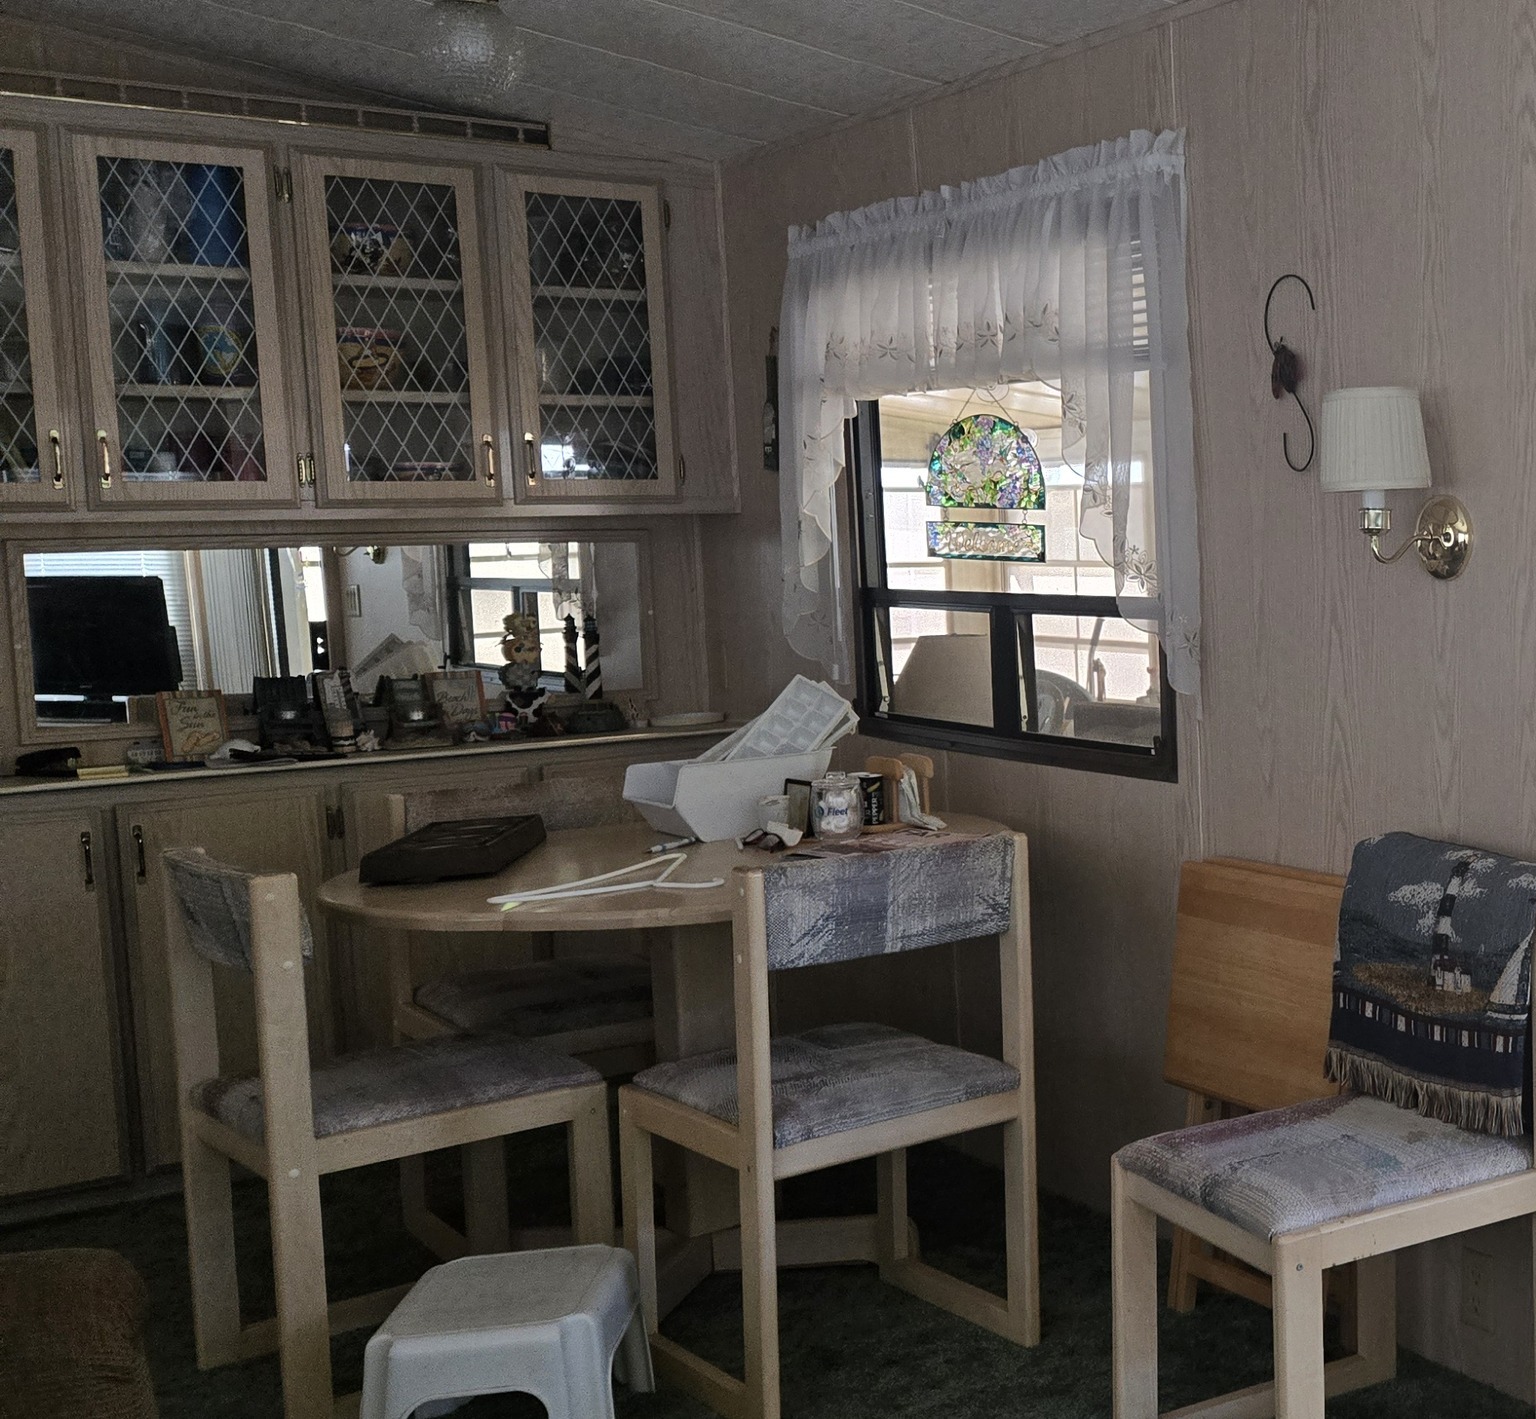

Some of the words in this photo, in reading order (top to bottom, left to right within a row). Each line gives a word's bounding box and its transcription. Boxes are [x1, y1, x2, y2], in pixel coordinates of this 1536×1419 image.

[939, 529, 1024, 553] Welcome
[171, 701, 198, 715] Fun
[177, 716, 205, 731] Sun
[827, 807, 849, 817] Fleet
